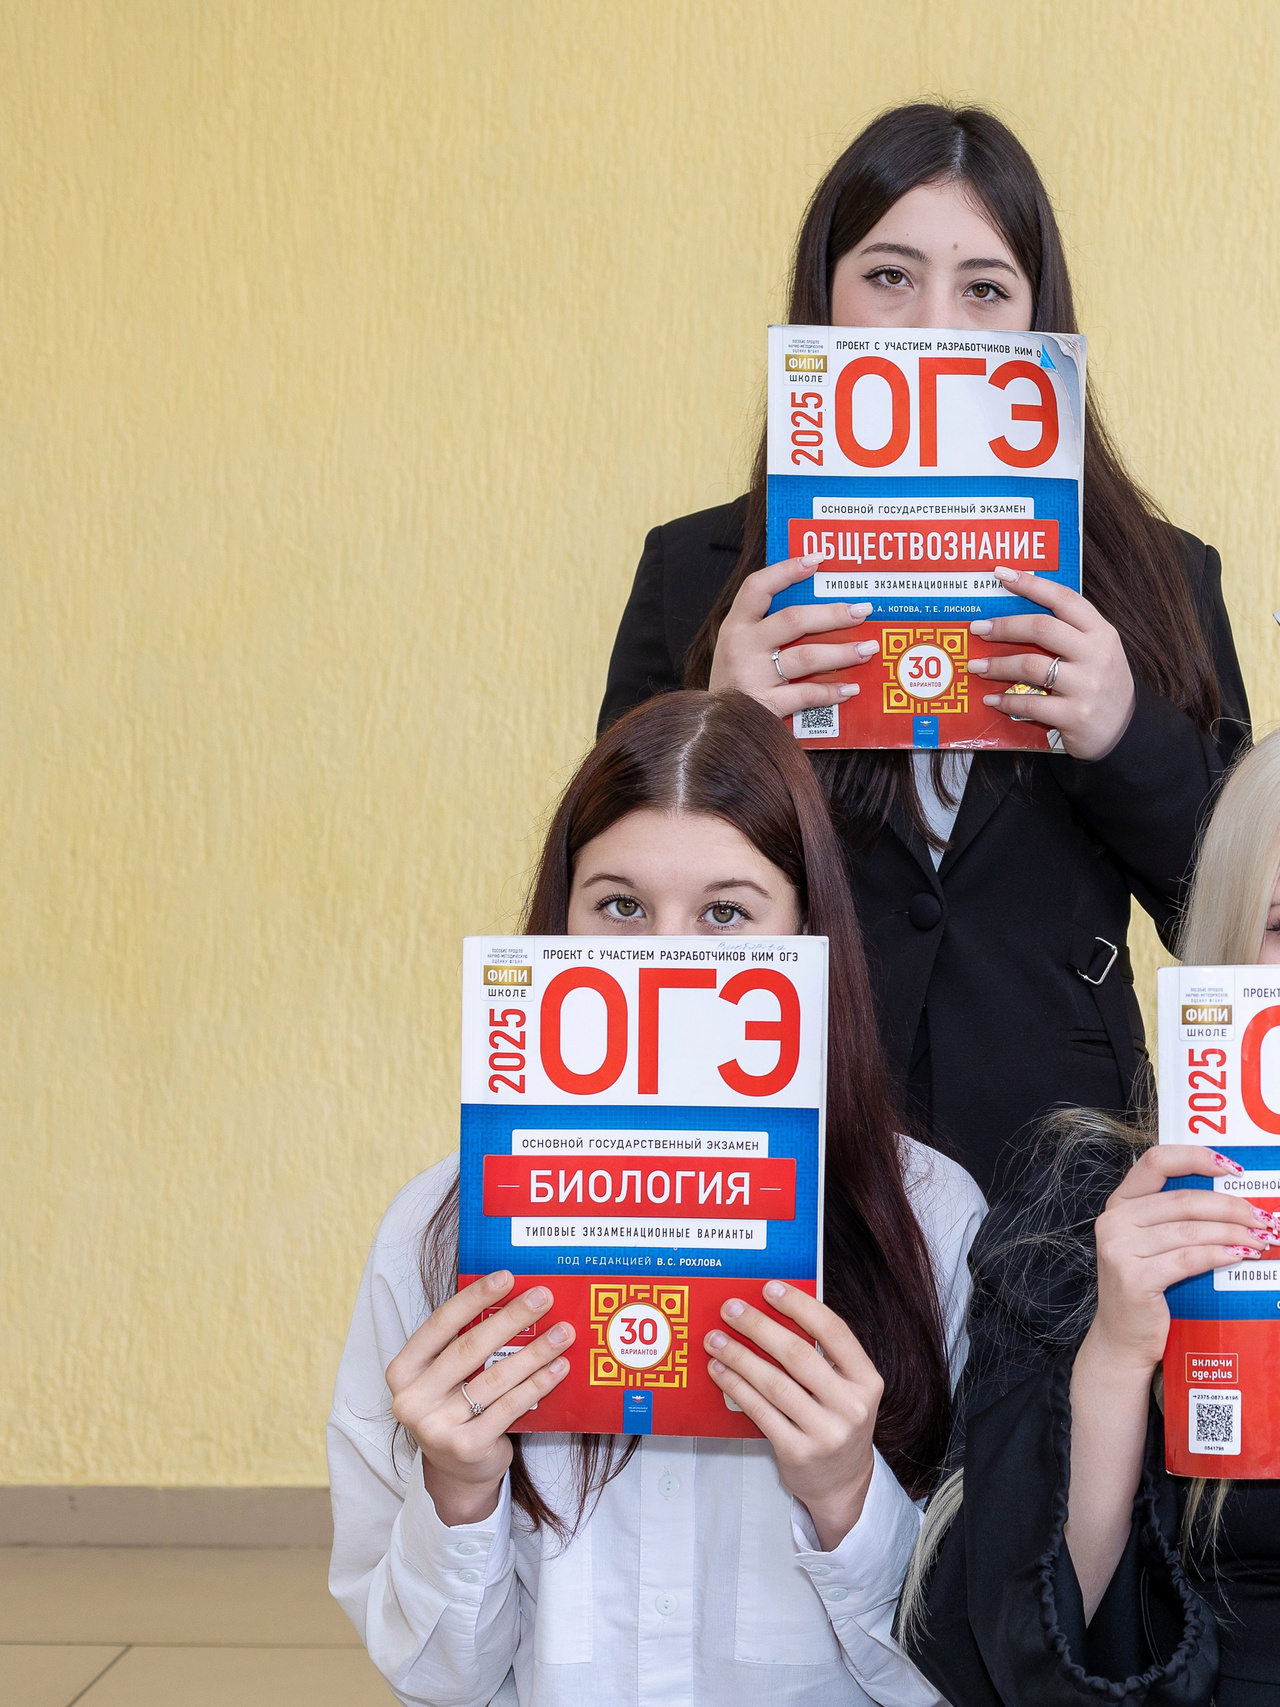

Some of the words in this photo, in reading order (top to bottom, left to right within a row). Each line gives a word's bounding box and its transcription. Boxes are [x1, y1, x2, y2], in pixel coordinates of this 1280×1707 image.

[836, 341, 870, 350] ПРОЕКТ
[874, 341, 880, 350] С
[884, 342, 932, 351] УЧАСТИЕМ
[937, 342, 1010, 354] РАЗРАБОТЧИКОВ
[1014, 346, 1032, 356] КИМ
[788, 358, 824, 370] ФИПИ
[790, 375, 823, 383] ШКОЛЕ
[834, 356, 1059, 468] ОГЭ
[791, 392, 823, 466] 2025
[821, 504, 873, 514] ОСНОВНОЙ
[878, 504, 976, 515] ГОСУДАРСТВЕННЫЙ
[980, 505, 1025, 513] ЭКЗАМЕН
[803, 531, 1046, 564] ОБЩЕСТВОЗНАНИЕ
[826, 580, 868, 589] ТИПОВЫЕ
[874, 580, 967, 590] ЭКЗАМЕНАЦИОННЫЕ
[973, 579, 1004, 590] ВАРИА
[888, 605, 922, 613] КОТОВА,
[908, 656, 941, 679] 30
[543, 949, 582, 960] ПРОЕКТ
[588, 950, 594, 960] С
[600, 950, 654, 960] УЧАСТИЕМ
[660, 950, 746, 961] РАЗРАБОТЧИКОВ
[752, 952, 773, 961] КИМ
[779, 952, 798, 962] ОГЭ
[487, 968, 528, 984] ФИПИ
[488, 989, 526, 997] ШКОЛЕ
[1243, 988, 1280, 998] ПРОЕКТ
[1185, 1007, 1228, 1023] ФИПИ
[540, 966, 801, 1097] ОГЭ
[1187, 1028, 1226, 1037] ШКОЛЕ
[488, 1008, 526, 1094] 2025
[1188, 1048, 1227, 1134] 2025
[522, 1137, 583, 1148] ОСНОВНОЙ
[589, 1138, 701, 1150] ГОСУДАРСТВЕННЫЙ
[707, 1140, 759, 1150] ЭКЗАМЕН
[530, 1170, 750, 1205] БИОЛОГИЯ
[526, 1226, 575, 1237] ТИПОВЫЕ
[583, 1226, 690, 1238] ЭКЗАМЕНАЦИОННЫЕ
[697, 1228, 753, 1239] ВАРИАНТЫ
[558, 1256, 580, 1266] ПОД
[585, 1256, 651, 1266] РЕДАКЦИЕЙ
[680, 1258, 722, 1267] РОХЛОВА
[1228, 1270, 1277, 1281] ТИПОВЫЕ
[620, 1318, 657, 1345] 30
[621, 1348, 657, 1356] ВАРИАНТОВ
[1192, 1359, 1232, 1367] включи
[1192, 1368, 1233, 1381] oge.plus
